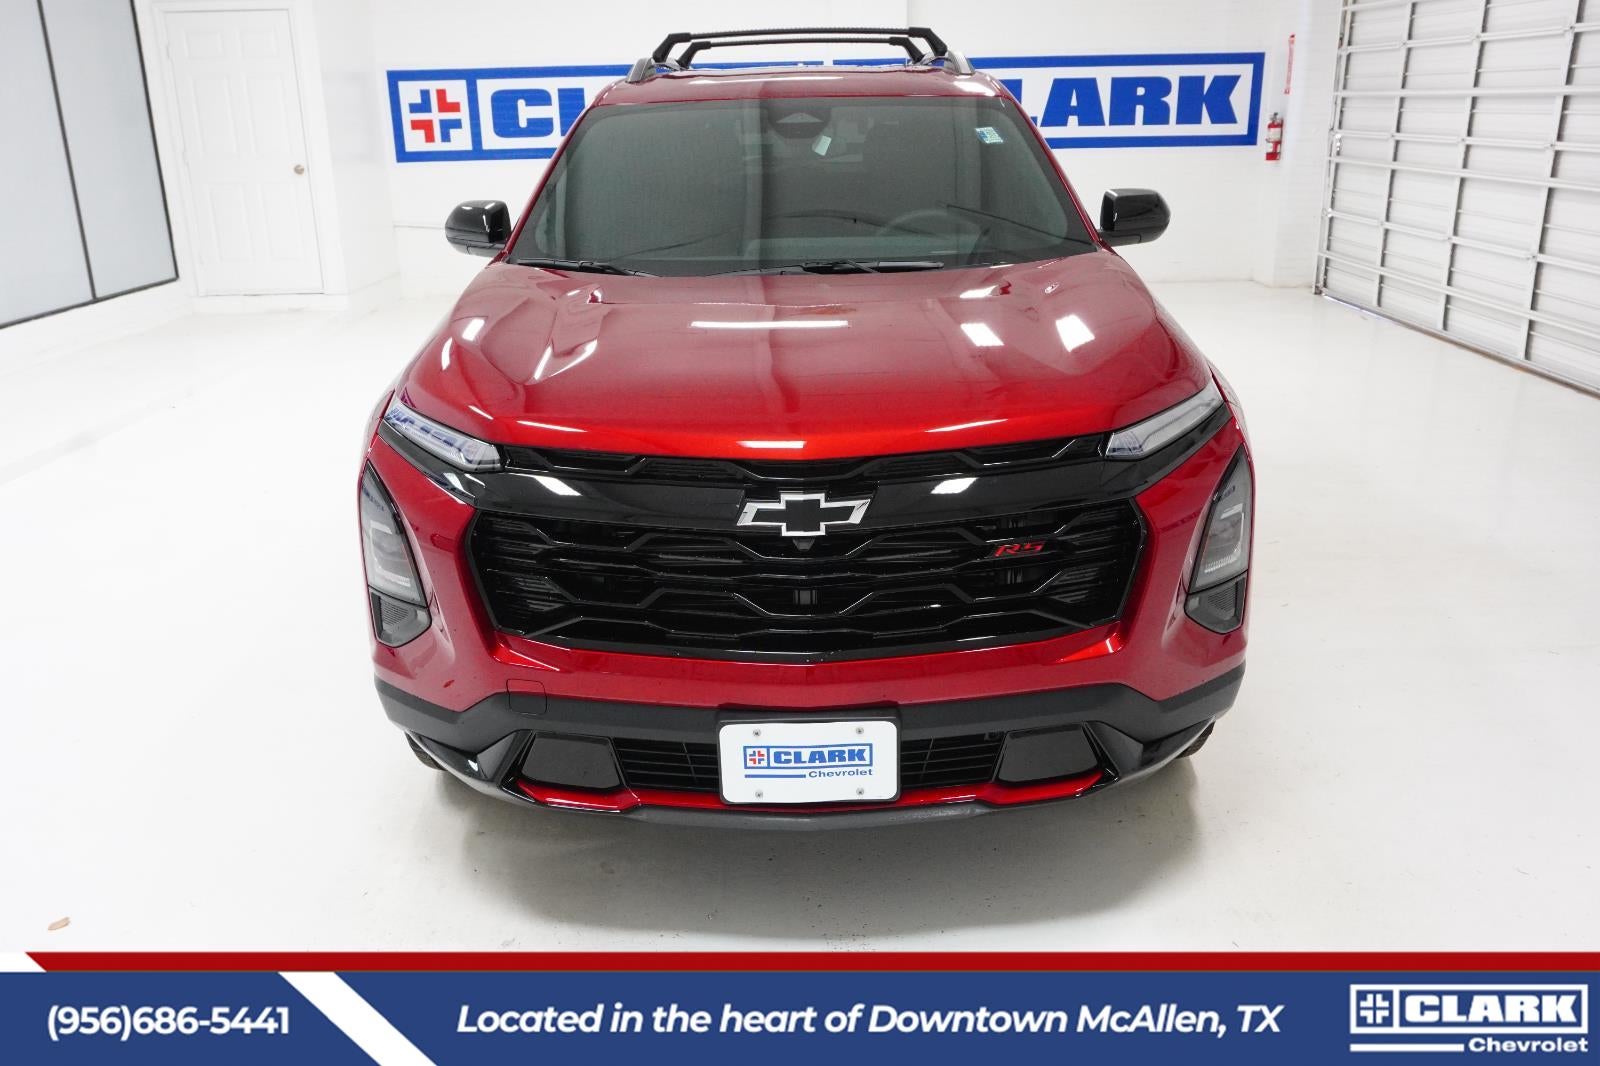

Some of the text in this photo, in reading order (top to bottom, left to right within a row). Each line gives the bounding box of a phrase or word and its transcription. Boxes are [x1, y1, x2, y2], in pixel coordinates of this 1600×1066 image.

[993, 541, 1045, 558] RS
[773, 748, 867, 765] CLARK
[808, 768, 873, 779] Chevrolet
